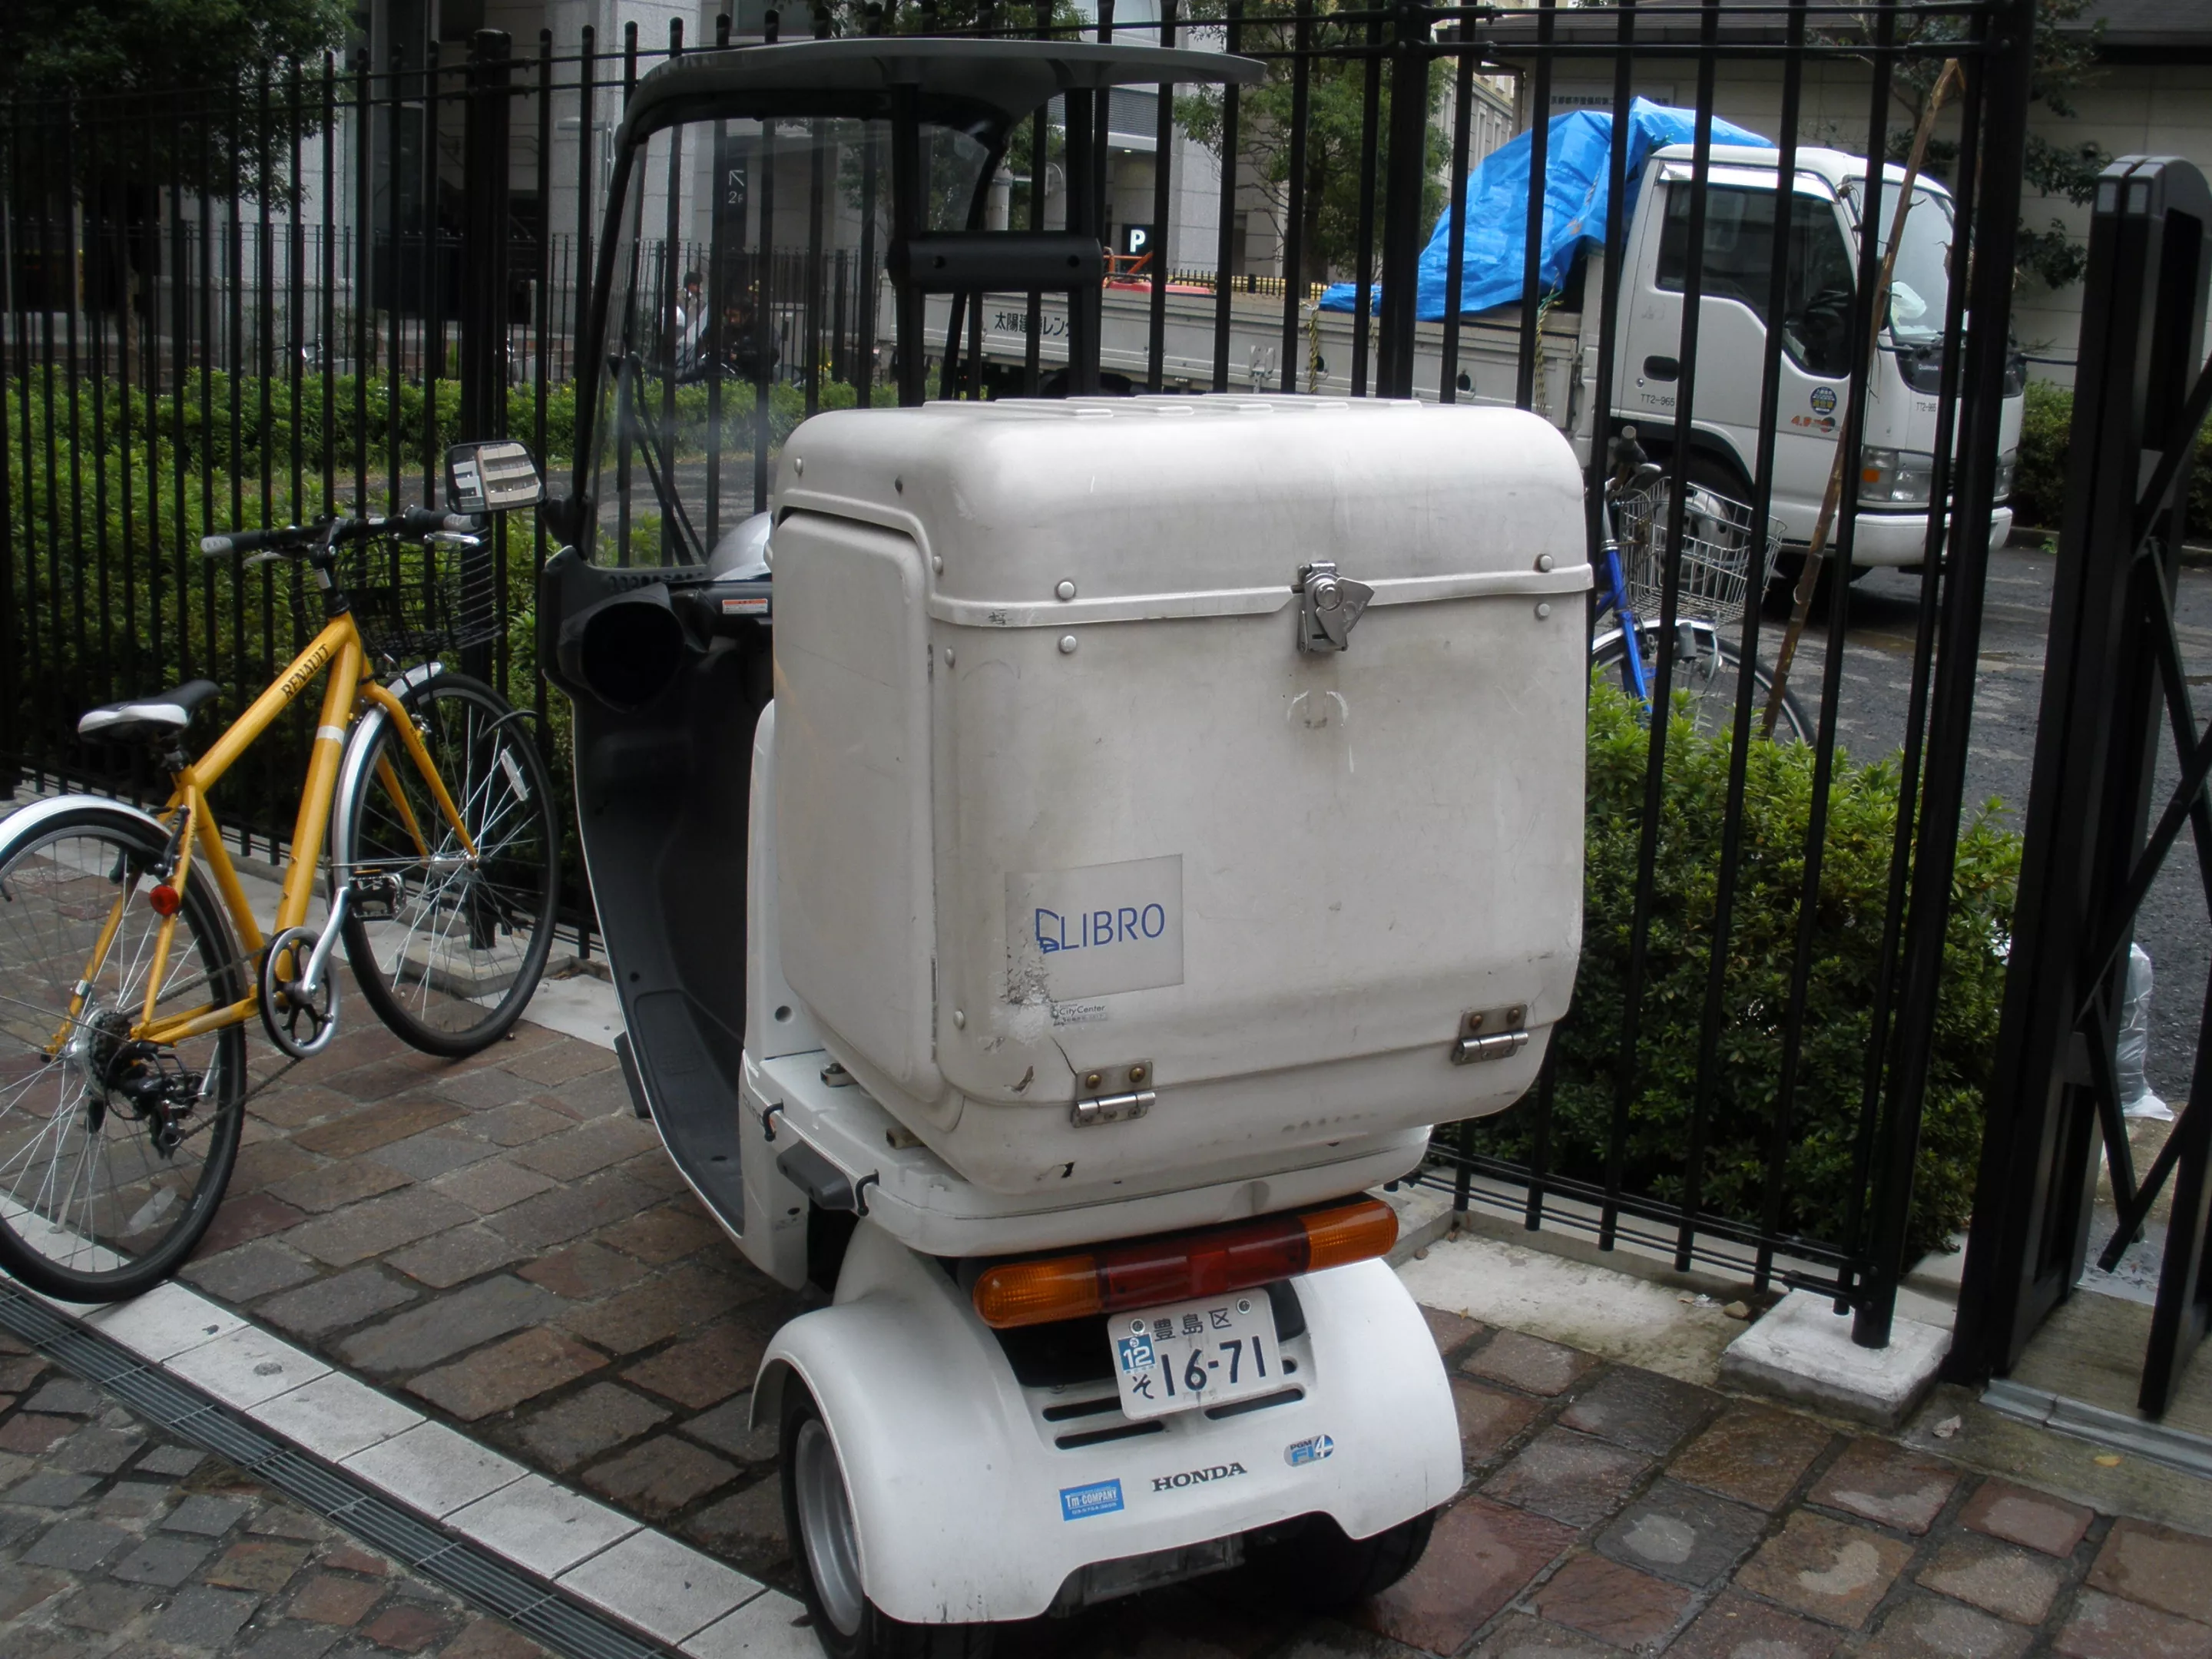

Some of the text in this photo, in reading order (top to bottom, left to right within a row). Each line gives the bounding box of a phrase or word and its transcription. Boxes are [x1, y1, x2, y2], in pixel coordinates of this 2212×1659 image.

[1130, 229, 1146, 253] P
[1641, 392, 1675, 406] TT2-965
[281, 644, 329, 700] RENAULT
[1061, 903, 1165, 950] LIBRO
[1154, 1307, 1232, 1342] 豊島区
[1124, 1346, 1152, 1368] 12
[1161, 1335, 1267, 1396] 16-71
[1133, 1373, 1154, 1399] そ
[1151, 1462, 1247, 1492] HONDA
